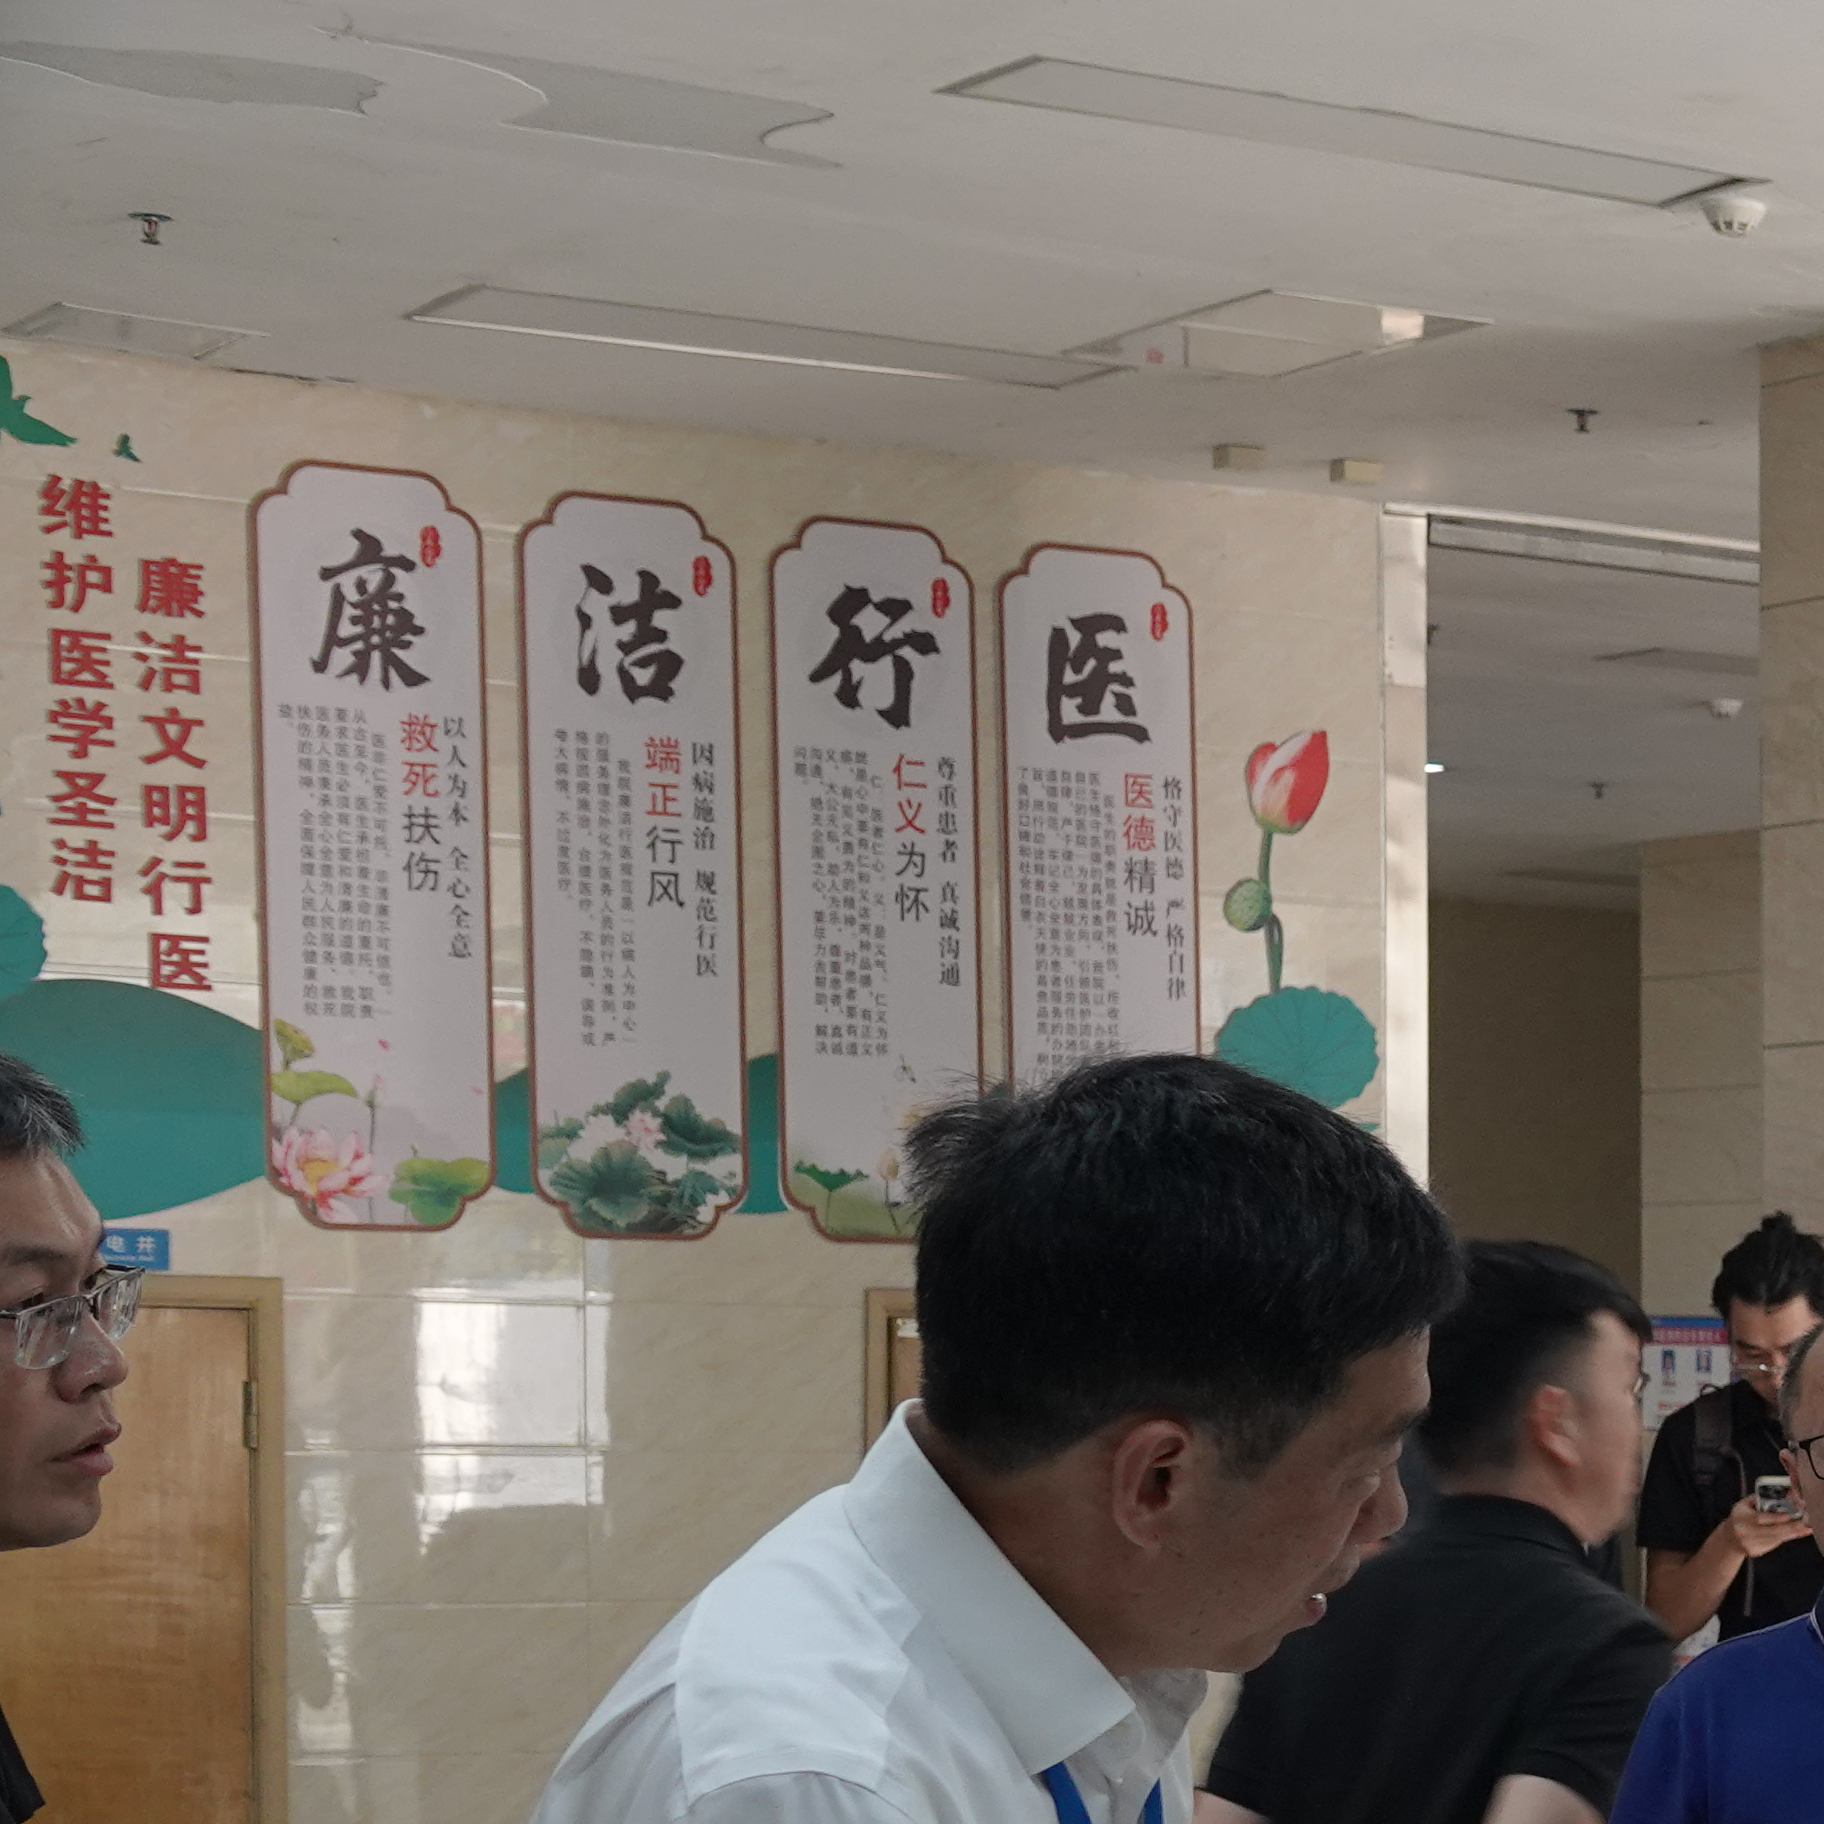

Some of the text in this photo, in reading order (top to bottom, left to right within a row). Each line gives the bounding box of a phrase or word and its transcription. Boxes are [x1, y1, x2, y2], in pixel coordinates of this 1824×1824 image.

[37, 474, 117, 904] 维护医学圣洁
[311, 529, 431, 691] 廉
[575, 564, 688, 706] 洁
[809, 585, 941, 729] 行
[1047, 613, 1151, 745] 医
[134, 557, 213, 993] 廉洁文明行医
[400, 712, 441, 891] 救死扶伤
[443, 716, 468, 827] 以人为本
[644, 736, 684, 908] 端正行风
[893, 754, 929, 922] 仁义为怀
[1123, 773, 1158, 937] 医德精诚
[691, 741, 718, 977] 因病施治 规范行医
[937, 756, 961, 986] 尊重患者 真诚沟通
[1163, 775, 1187, 1000] 恪守医德 严格自律
